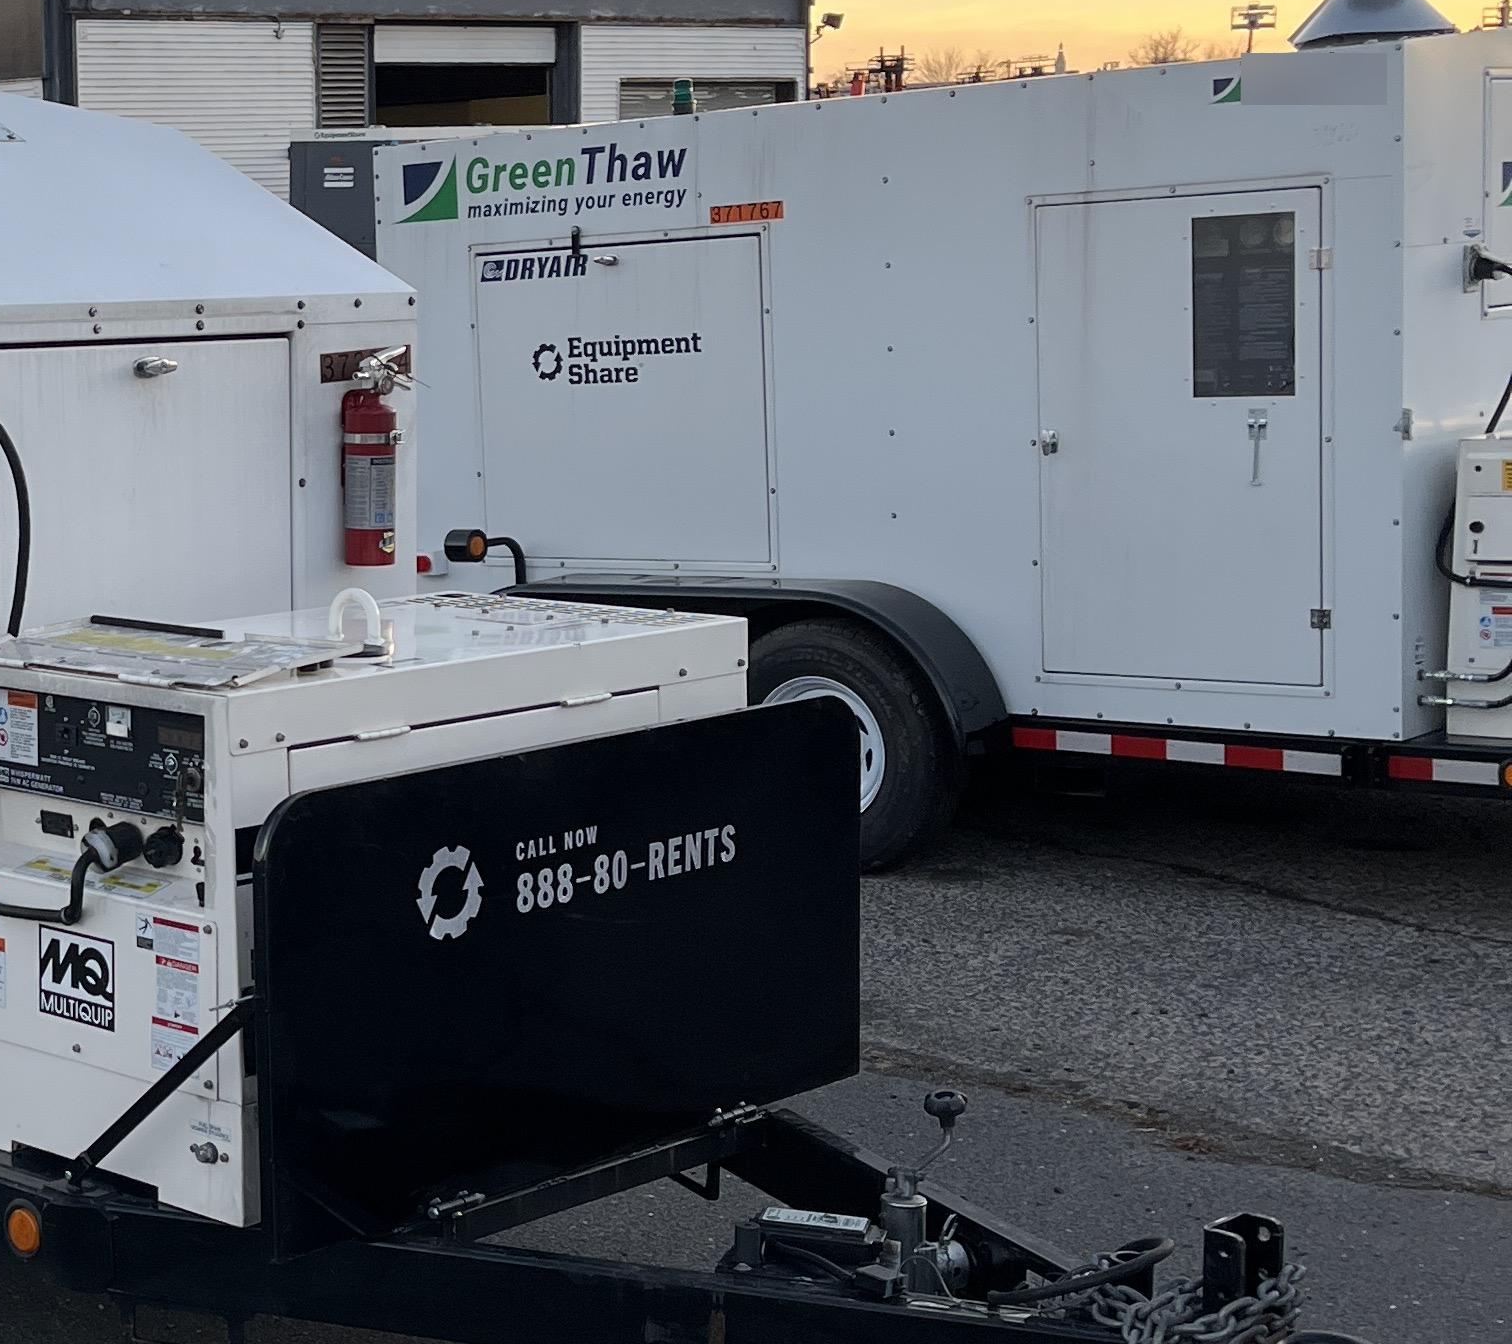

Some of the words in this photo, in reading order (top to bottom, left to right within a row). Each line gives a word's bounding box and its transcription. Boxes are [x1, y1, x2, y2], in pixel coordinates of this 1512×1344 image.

[466, 142, 688, 194] GreenThaw
[467, 195, 568, 218] maximizing
[574, 193, 616, 215] your
[622, 188, 688, 208] energy
[712, 201, 781, 223] 371767
[505, 254, 588, 281] DRYAIR
[568, 333, 702, 363] Equipment
[568, 363, 639, 385] Share
[516, 835, 557, 861] CALL
[564, 825, 598, 851] NOW
[516, 824, 736, 914] 888-80-RENTS
[40, 938, 114, 1002] MQ
[41, 992, 113, 1028] MULTIQUIP
